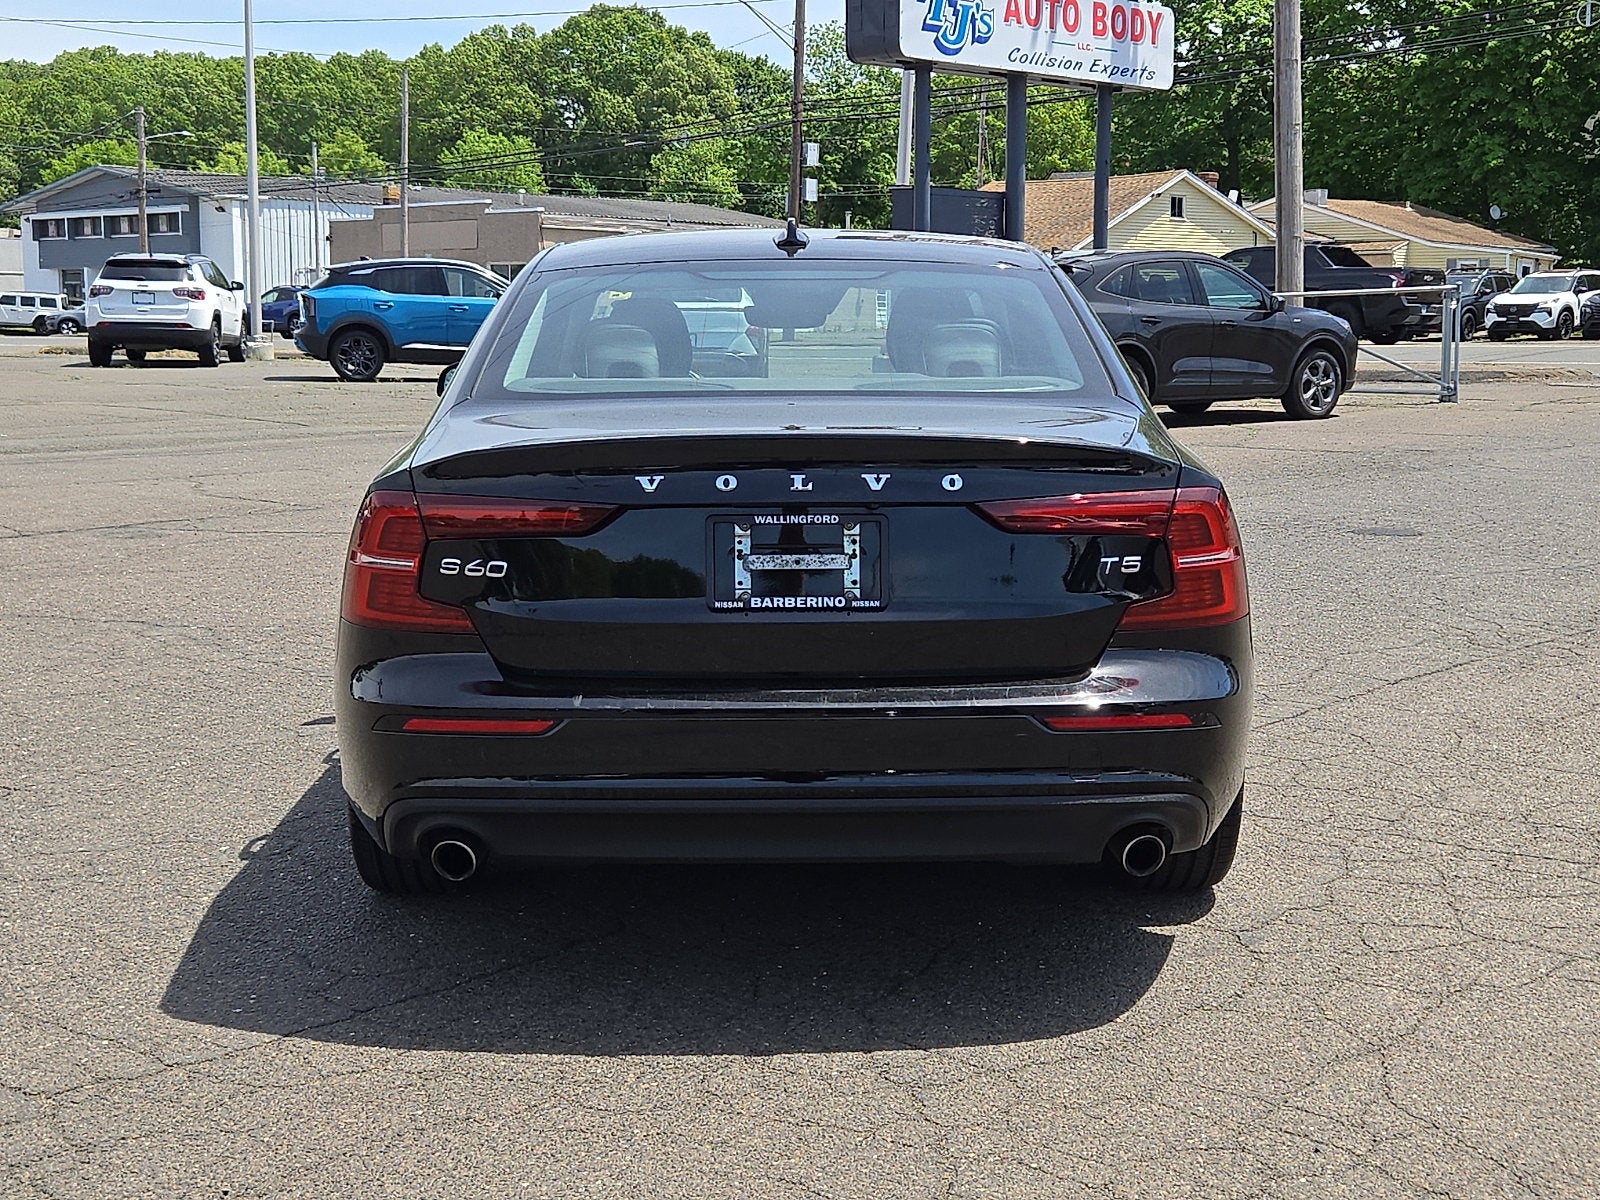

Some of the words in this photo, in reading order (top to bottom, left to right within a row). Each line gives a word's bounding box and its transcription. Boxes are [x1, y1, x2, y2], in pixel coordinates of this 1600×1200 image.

[1003, 0, 1080, 33] AUTO
[1092, 1, 1163, 45] BODY
[1007, 47, 1083, 71] Collision
[1089, 59, 1156, 80] Experts
[635, 474, 964, 492] VOLVO
[754, 515, 840, 524] WALLINGFORD
[440, 558, 508, 578] S60
[1100, 556, 1142, 575] T5
[750, 596, 846, 608] BARBERINO
